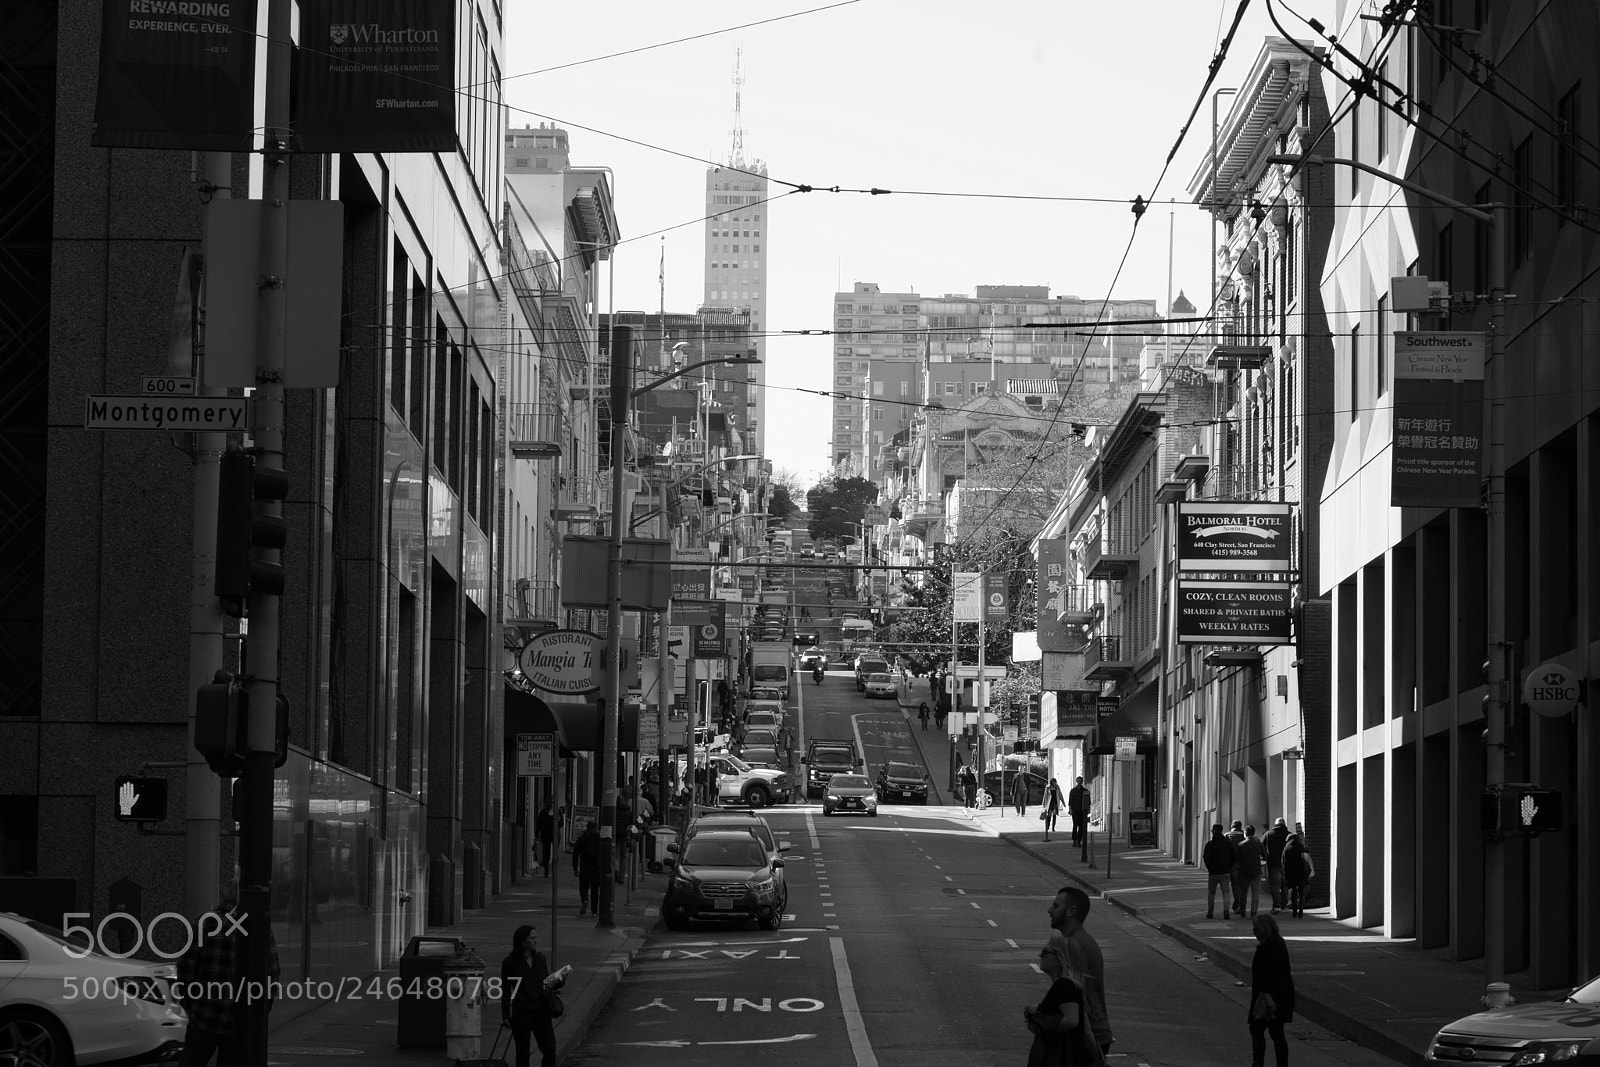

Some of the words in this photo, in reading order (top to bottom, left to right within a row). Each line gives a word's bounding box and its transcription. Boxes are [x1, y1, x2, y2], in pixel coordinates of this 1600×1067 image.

[129, 0, 230, 17] REWARDING
[129, 20, 199, 34] EXPERIENCE,
[201, 24, 232, 34] EVER.
[350, 23, 440, 44] Wharton
[329, 64, 378, 73] PHILADELPHIA
[375, 98, 440, 110] SFWharton.com
[1407, 336, 1467, 347] Southwest
[1437, 354, 1453, 363] New
[147, 380, 176, 392] 600
[92, 402, 243, 428] Montgomery
[1397, 418, 1451, 432] 新年遊行
[1454, 467, 1478, 475] Parade.
[1187, 515, 1244, 526] BALMORAL
[1245, 516, 1282, 527] HOTEL
[1205, 541, 1218, 550] Clay
[1185, 592, 1214, 602] COZY,
[1215, 593, 1247, 602] CLEAN
[1249, 594, 1283, 602] ROOMS
[1183, 608, 1216, 616] SHARED
[1225, 609, 1259, 617] PRIVATE
[1260, 609, 1286, 617] BATHS
[1199, 622, 1239, 631] WEEKLY
[1240, 623, 1271, 631] RATES
[541, 634, 593, 648] RISTORANT
[527, 650, 576, 673] Mangia
[533, 671, 567, 689] ITALIAN
[568, 677, 593, 690] CUISI
[1532, 687, 1576, 701] HSBC
[519, 741, 528, 750] NO
[662, 950, 801, 960] TAXI
[628, 998, 826, 1012] ONLY
